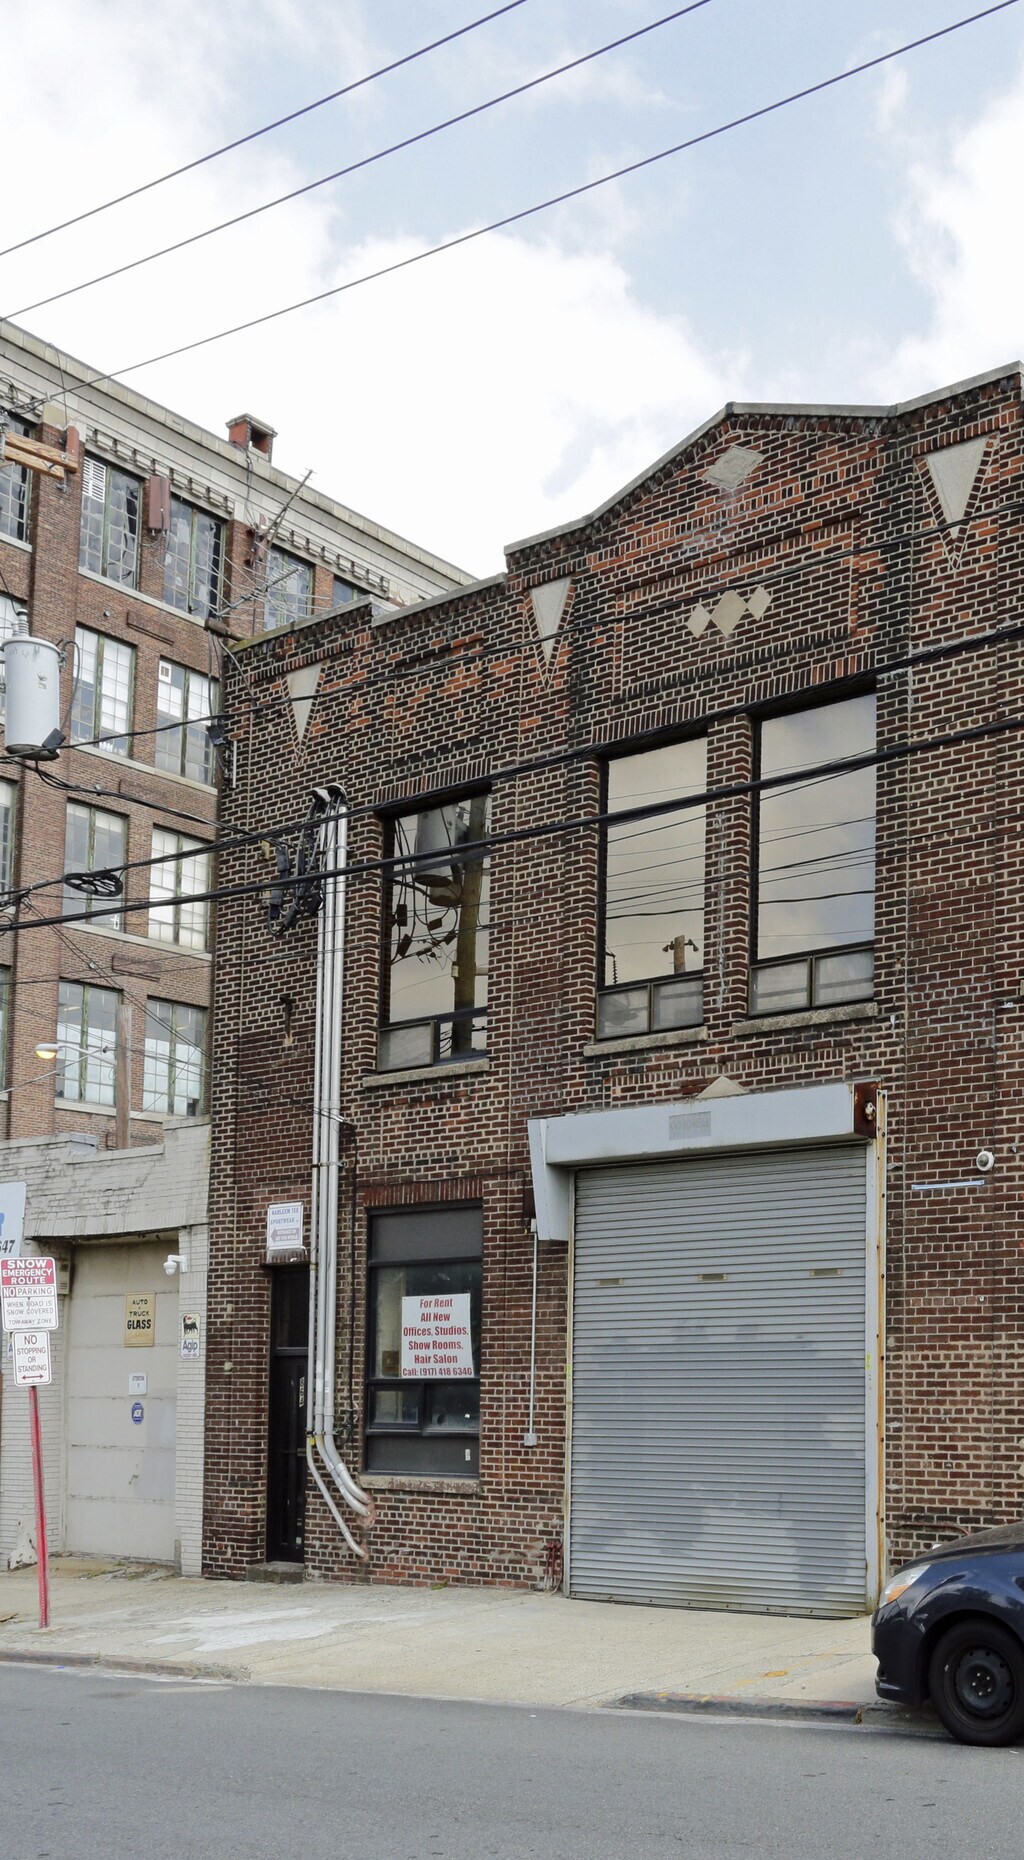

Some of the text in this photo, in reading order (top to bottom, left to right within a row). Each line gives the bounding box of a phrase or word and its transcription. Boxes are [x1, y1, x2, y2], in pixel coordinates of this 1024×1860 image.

[7, 1260, 47, 1269] SNOW
[2, 1269, 53, 1277] EMERGENCY
[11, 1277, 46, 1285] ROUTE
[3, 1287, 53, 1298] NO PARKING
[419, 1298, 453, 1309] For Rent
[420, 1312, 451, 1322] All New
[127, 1319, 152, 1330] GLASS
[403, 1325, 469, 1337] Offices, Studios,
[24, 1334, 38, 1345] NO
[16, 1346, 46, 1355] STOPPING
[182, 1340, 198, 1353] Agip
[408, 1340, 464, 1351] Show Rooms,
[414, 1353, 458, 1364] Hair Salon
[17, 1364, 47, 1373] STANDING
[402, 1367, 419, 1377] Call:
[419, 1367, 437, 1377] (917)
[438, 1367, 452, 1376] 418
